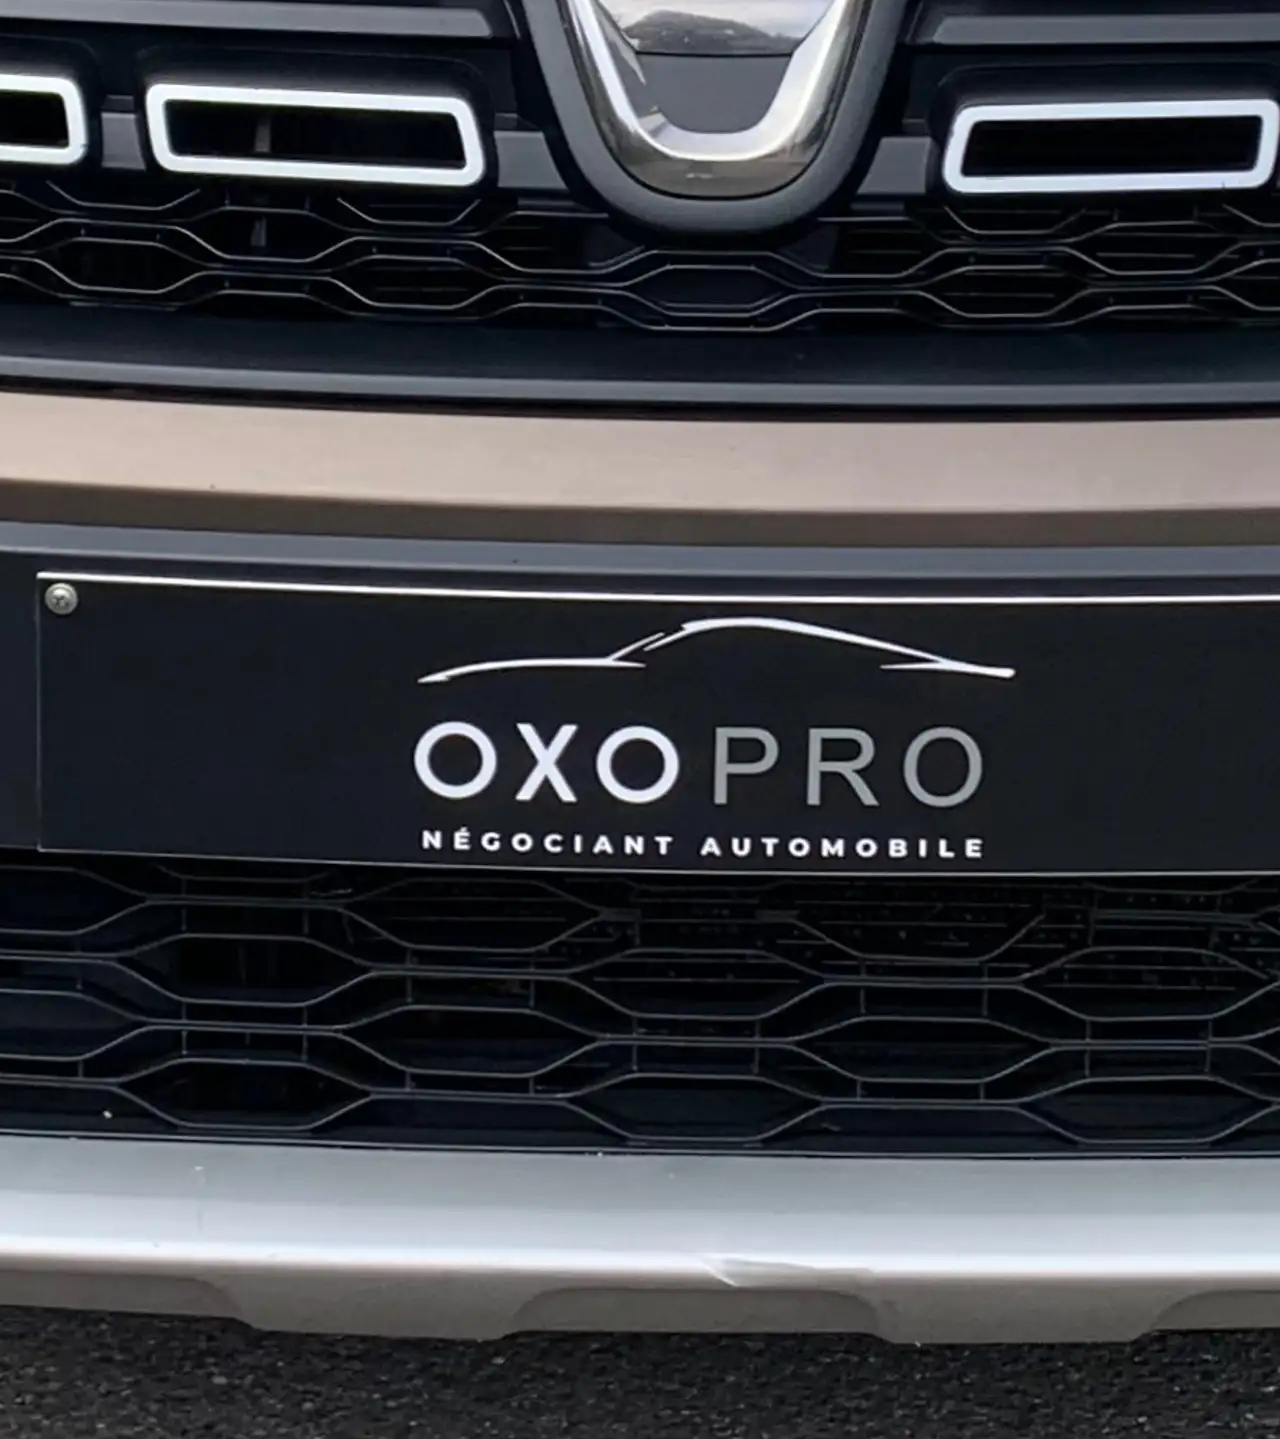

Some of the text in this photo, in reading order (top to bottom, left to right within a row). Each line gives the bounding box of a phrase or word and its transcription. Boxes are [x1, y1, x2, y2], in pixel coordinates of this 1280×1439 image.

[413, 720, 983, 808] OXOPRO
[422, 827, 984, 858] NÉGOCIANT AUTOMOBILE
